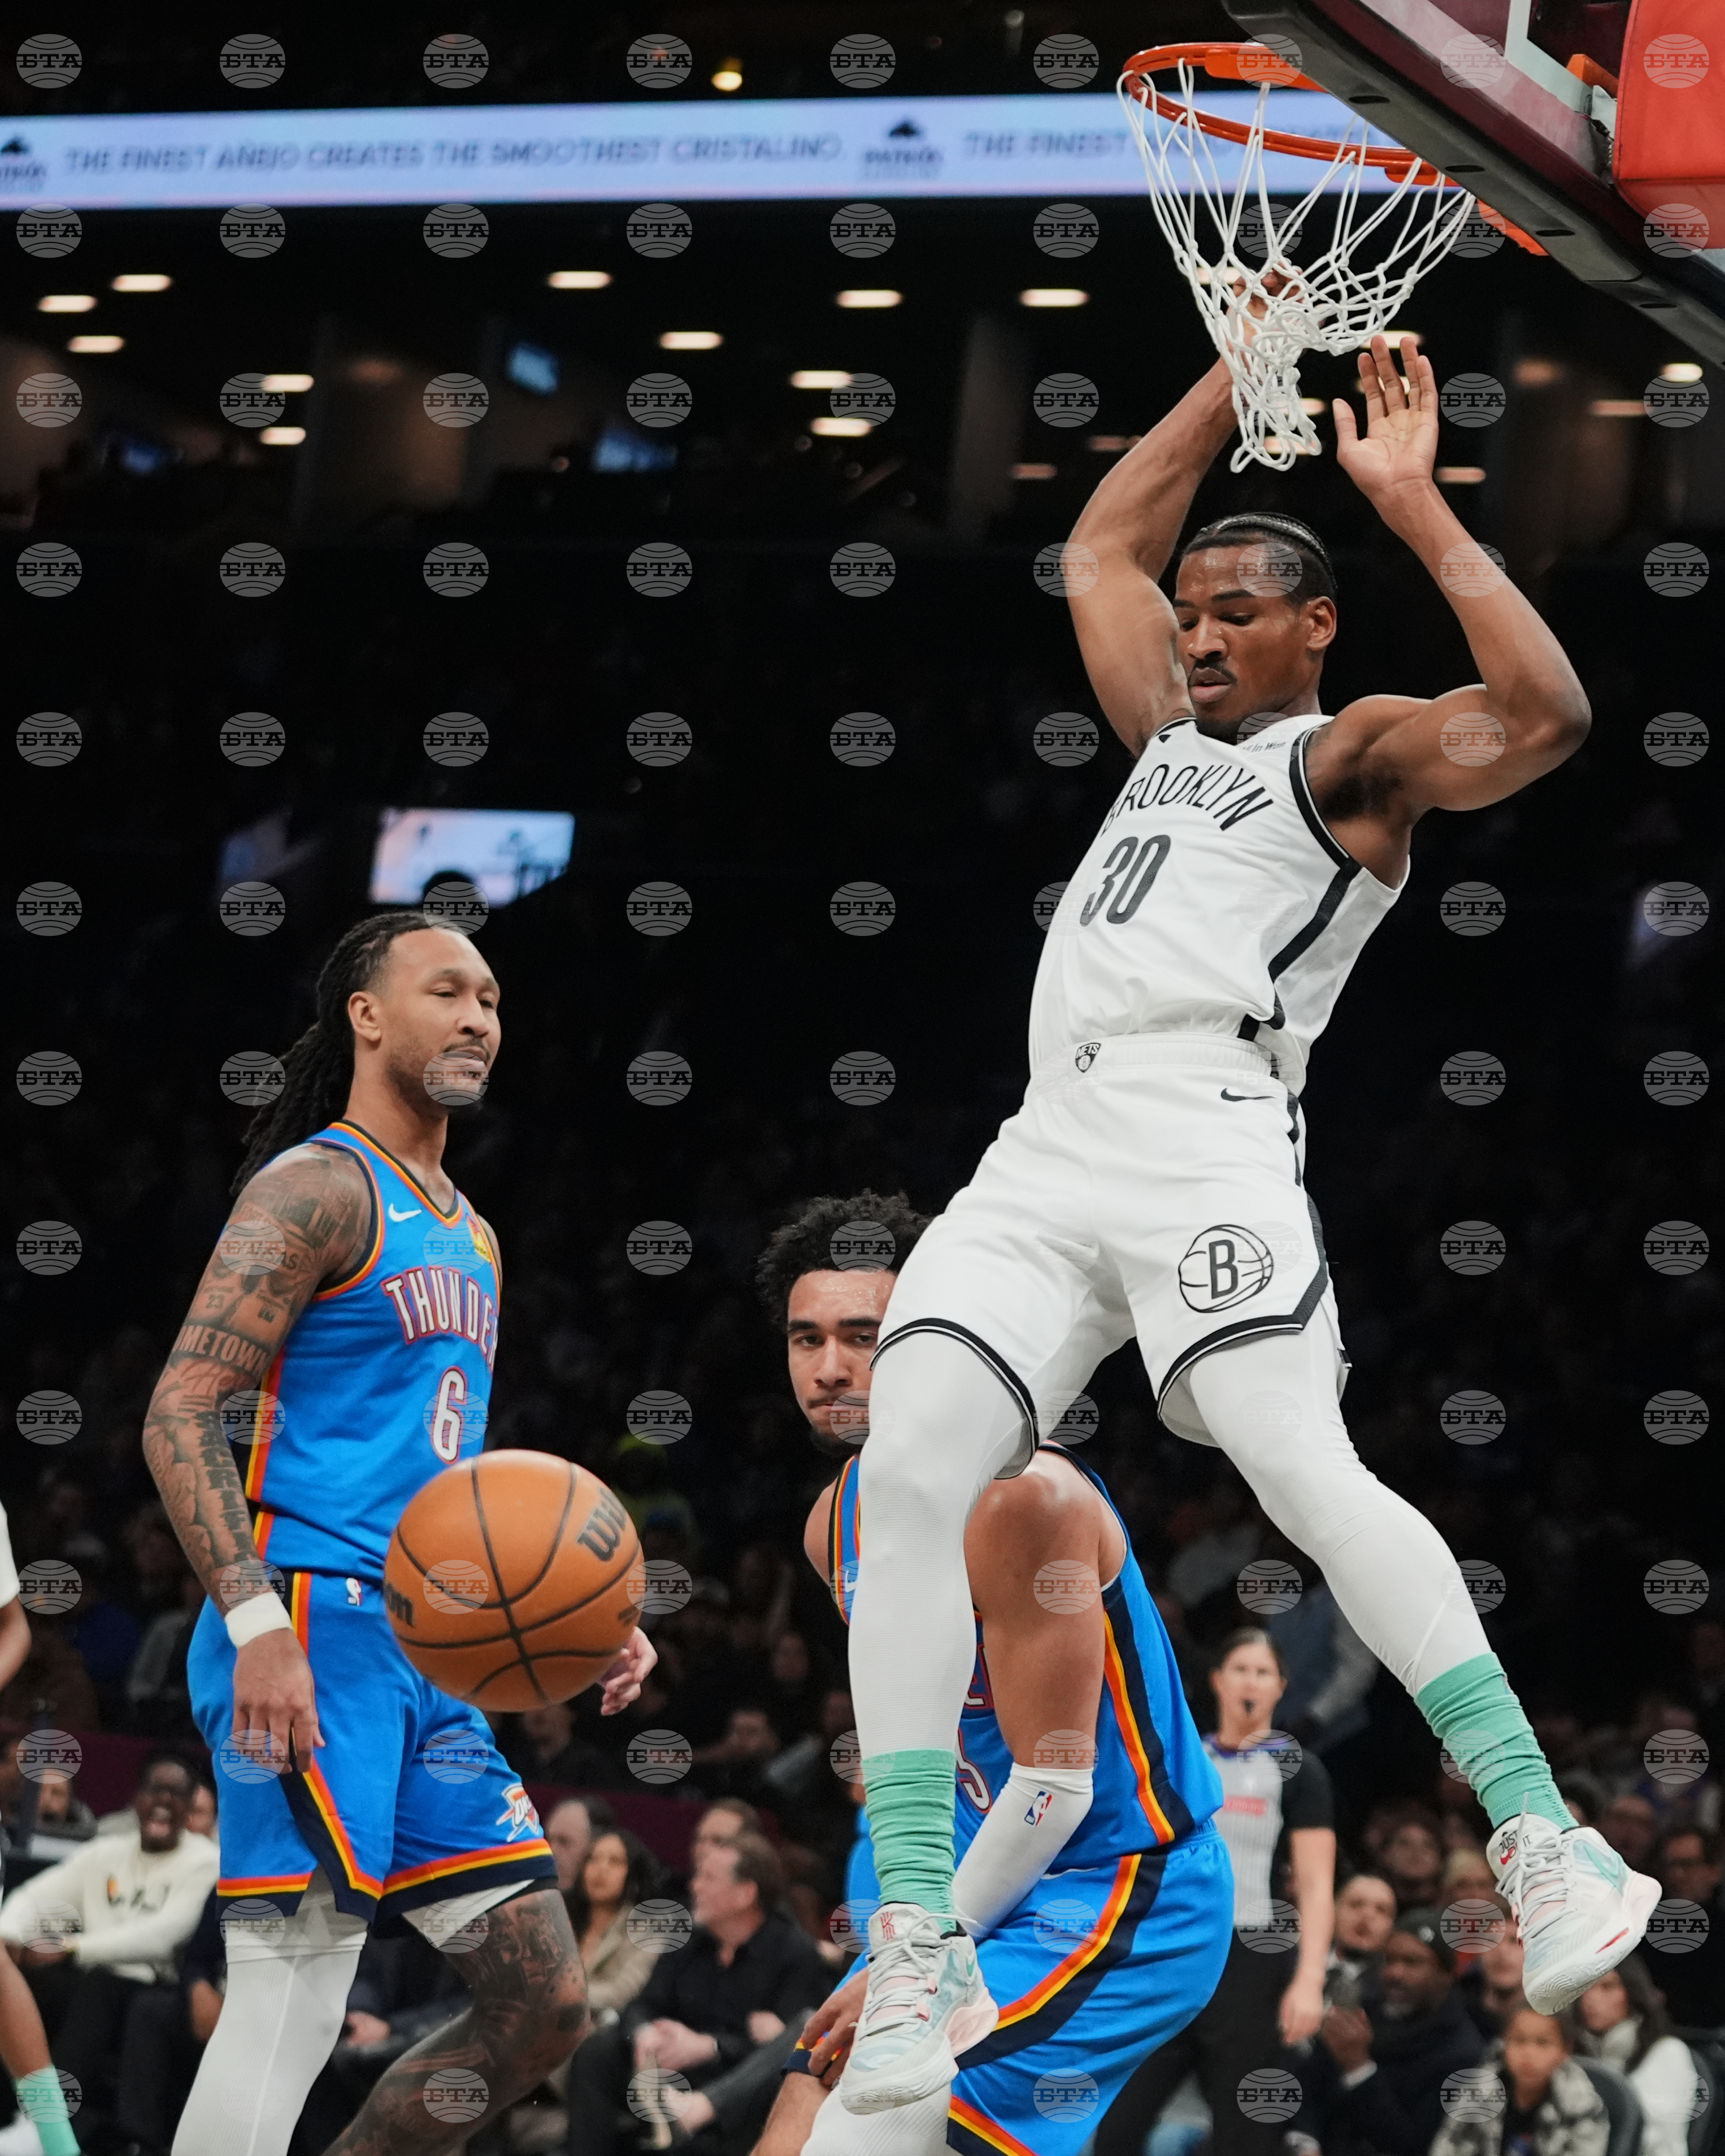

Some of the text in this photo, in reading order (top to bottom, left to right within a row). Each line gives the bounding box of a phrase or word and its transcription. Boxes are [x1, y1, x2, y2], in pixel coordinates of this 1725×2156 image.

[120, 145, 210, 171] FINEST
[434, 140, 479, 166] THE
[1264, 741, 1287, 751] Won
[1100, 764, 1274, 838] BROOKLYN
[1080, 834, 1171, 927] 30
[1075, 1044, 1100, 1060] NETS
[1209, 1239, 1239, 1299] B
[431, 1366, 467, 1464] 6
[1499, 1830, 1518, 1854] JUST
